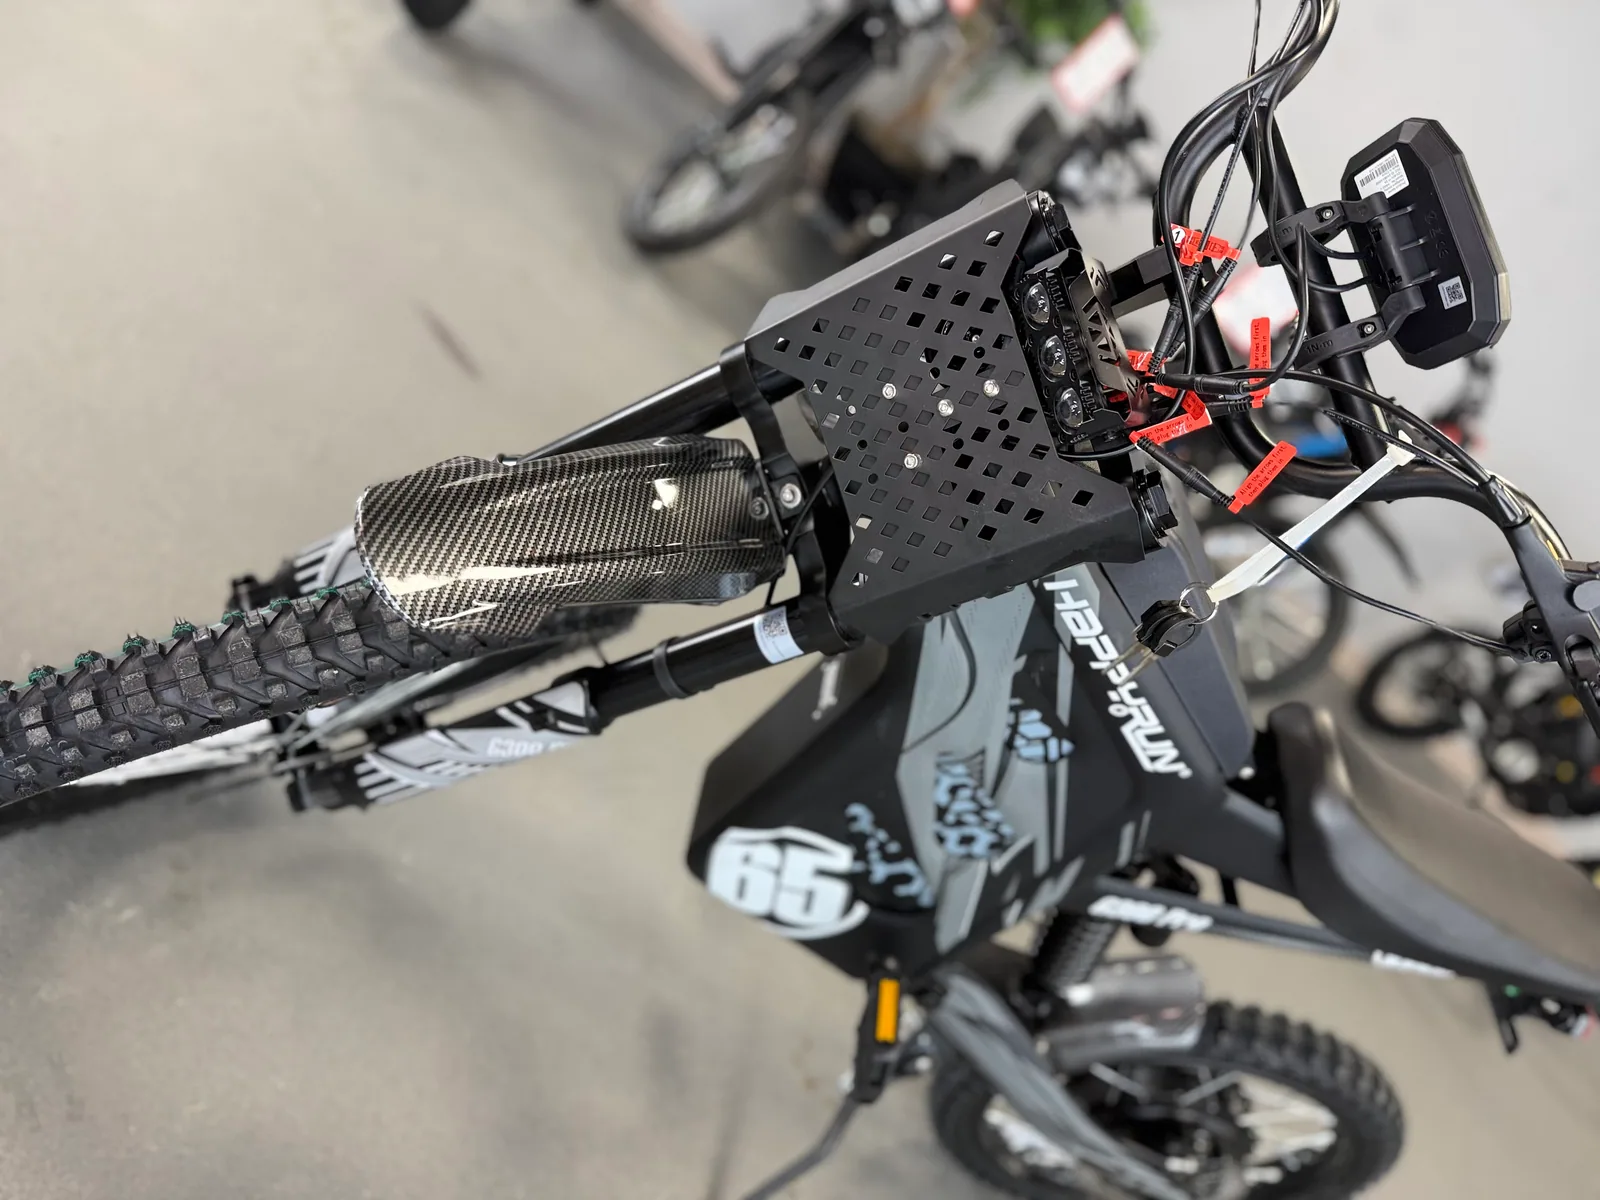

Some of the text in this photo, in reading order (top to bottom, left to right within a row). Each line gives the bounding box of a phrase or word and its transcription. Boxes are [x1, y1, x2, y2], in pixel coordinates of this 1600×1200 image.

[1174, 230, 1181, 242] 1
[1239, 483, 1254, 498] Align
[1251, 473, 1261, 483] the
[1248, 487, 1260, 499] then
[1256, 474, 1270, 488] plug
[706, 842, 853, 928] 65
